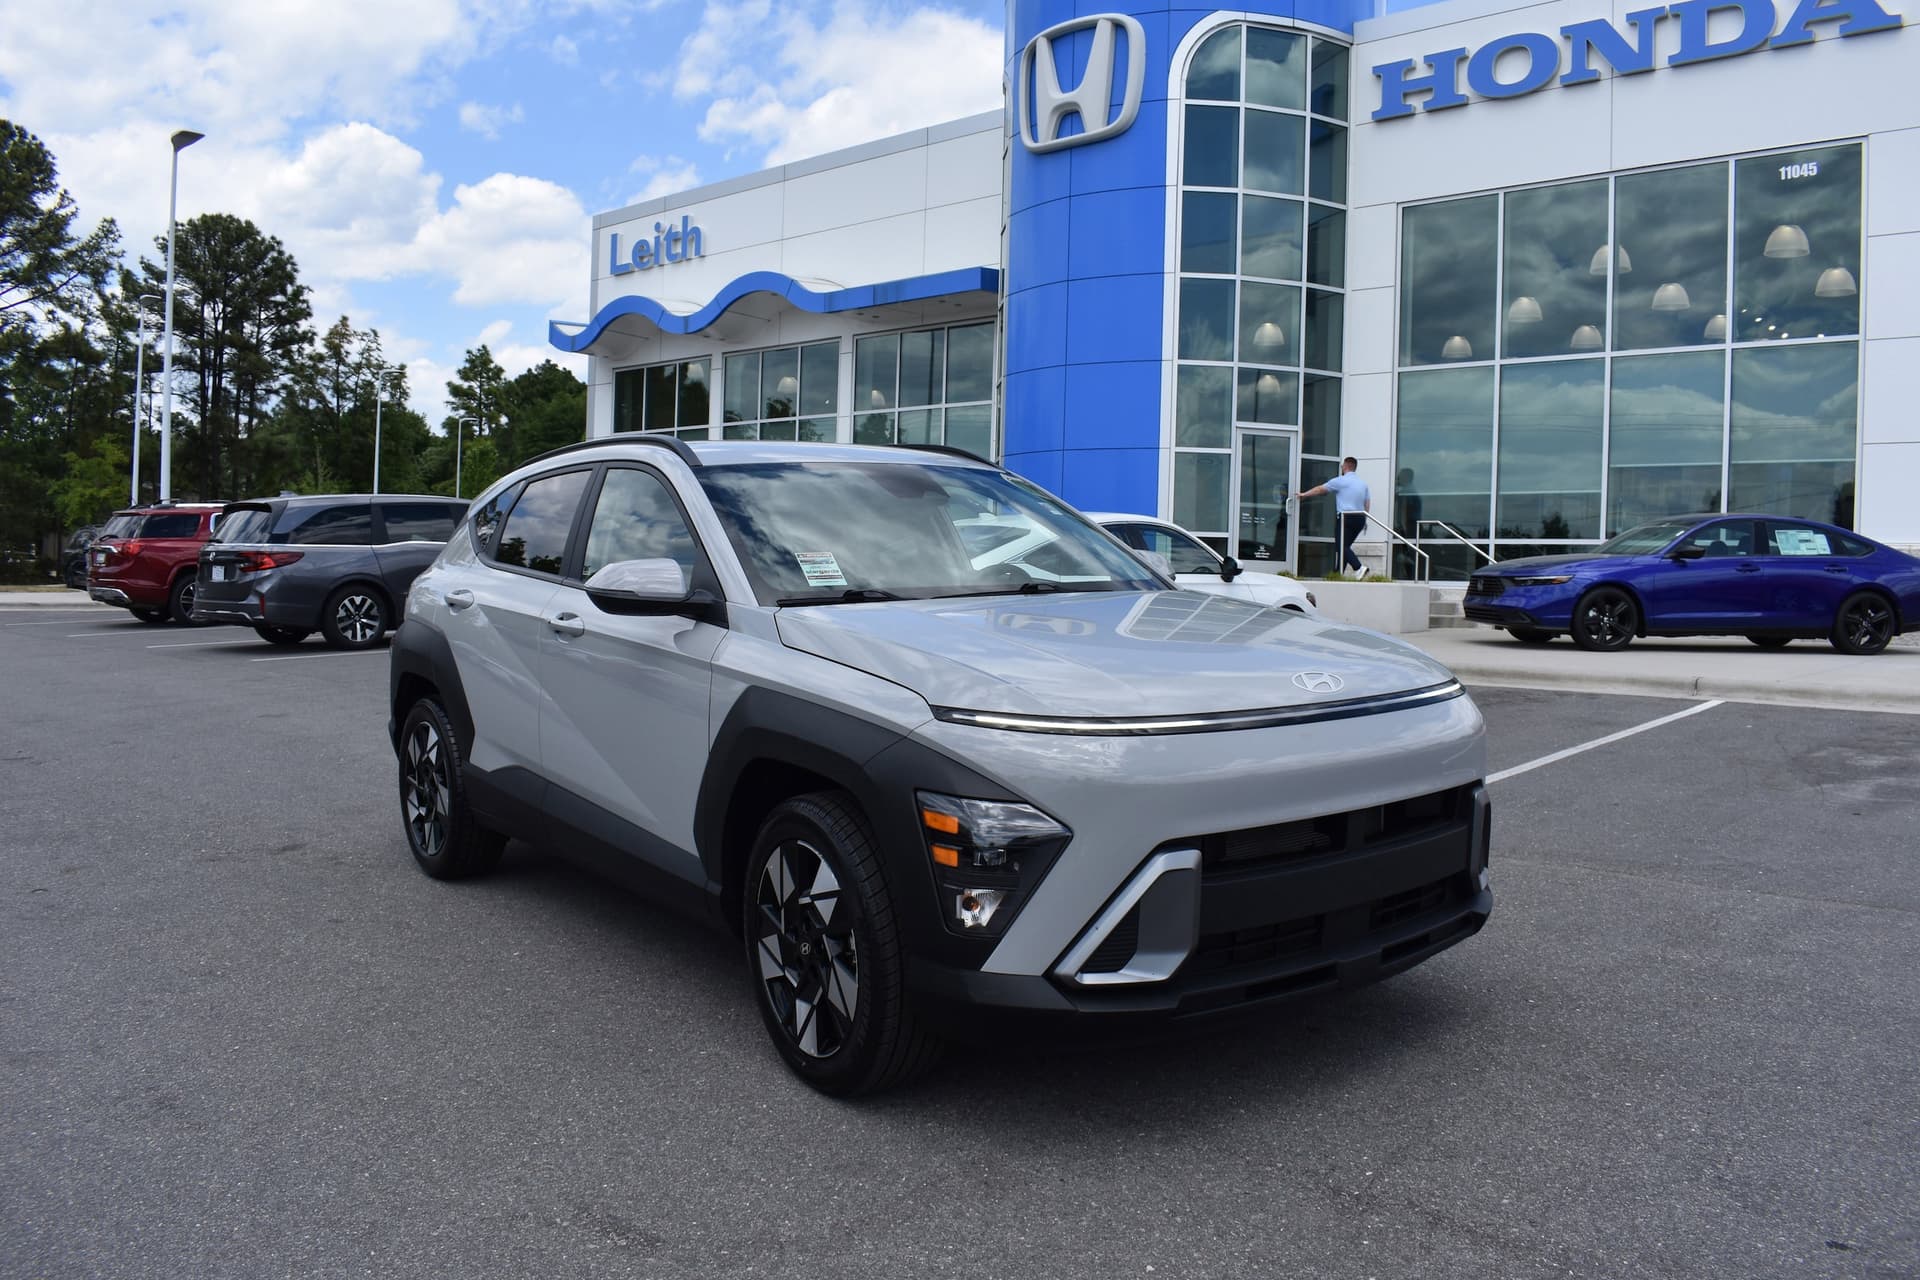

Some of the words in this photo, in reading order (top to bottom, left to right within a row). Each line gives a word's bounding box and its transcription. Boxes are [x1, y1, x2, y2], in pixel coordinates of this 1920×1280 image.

[1371, 0, 1902, 120] HONDA
[1779, 162, 1817, 180] 11045
[610, 215, 702, 275] Leith
